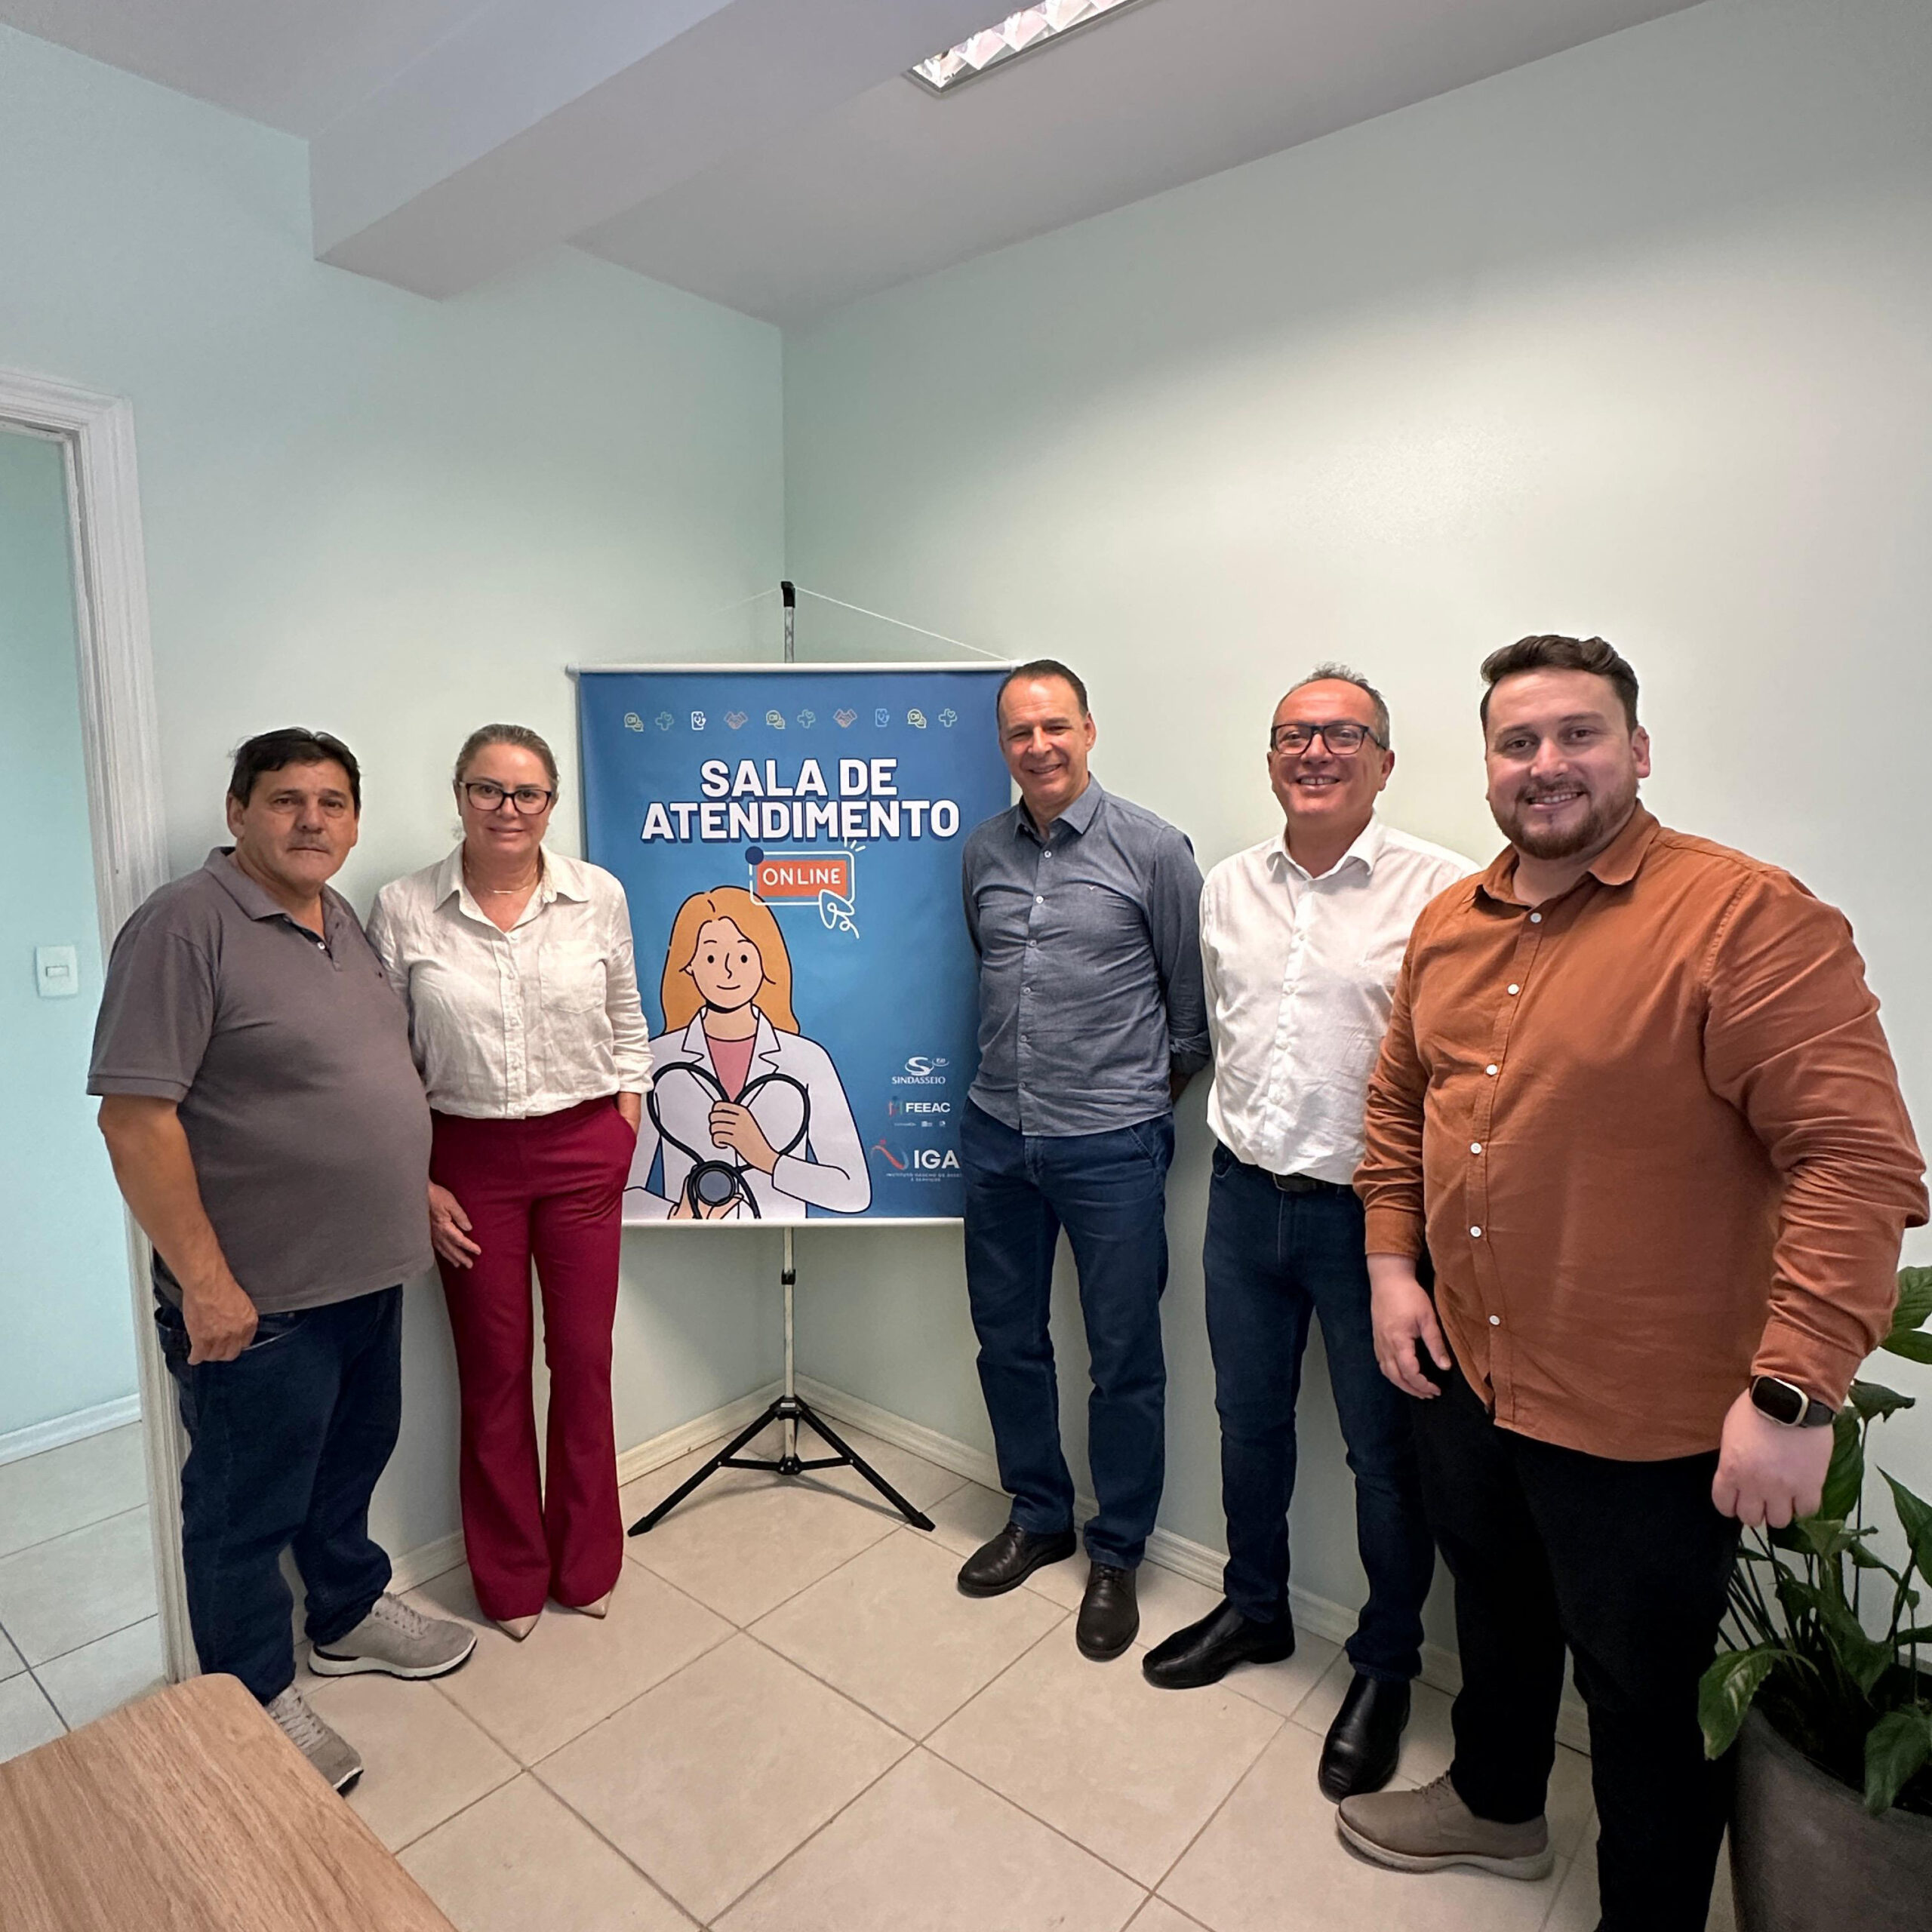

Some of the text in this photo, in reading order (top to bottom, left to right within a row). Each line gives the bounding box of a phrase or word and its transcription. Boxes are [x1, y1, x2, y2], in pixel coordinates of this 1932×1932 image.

[702, 758, 898, 796] SALA DE
[641, 800, 960, 839] ATENDIMENTO
[762, 867, 841, 885] ONLINE
[906, 1103, 951, 1113] FEEAC
[914, 1149, 960, 1169] IGA
